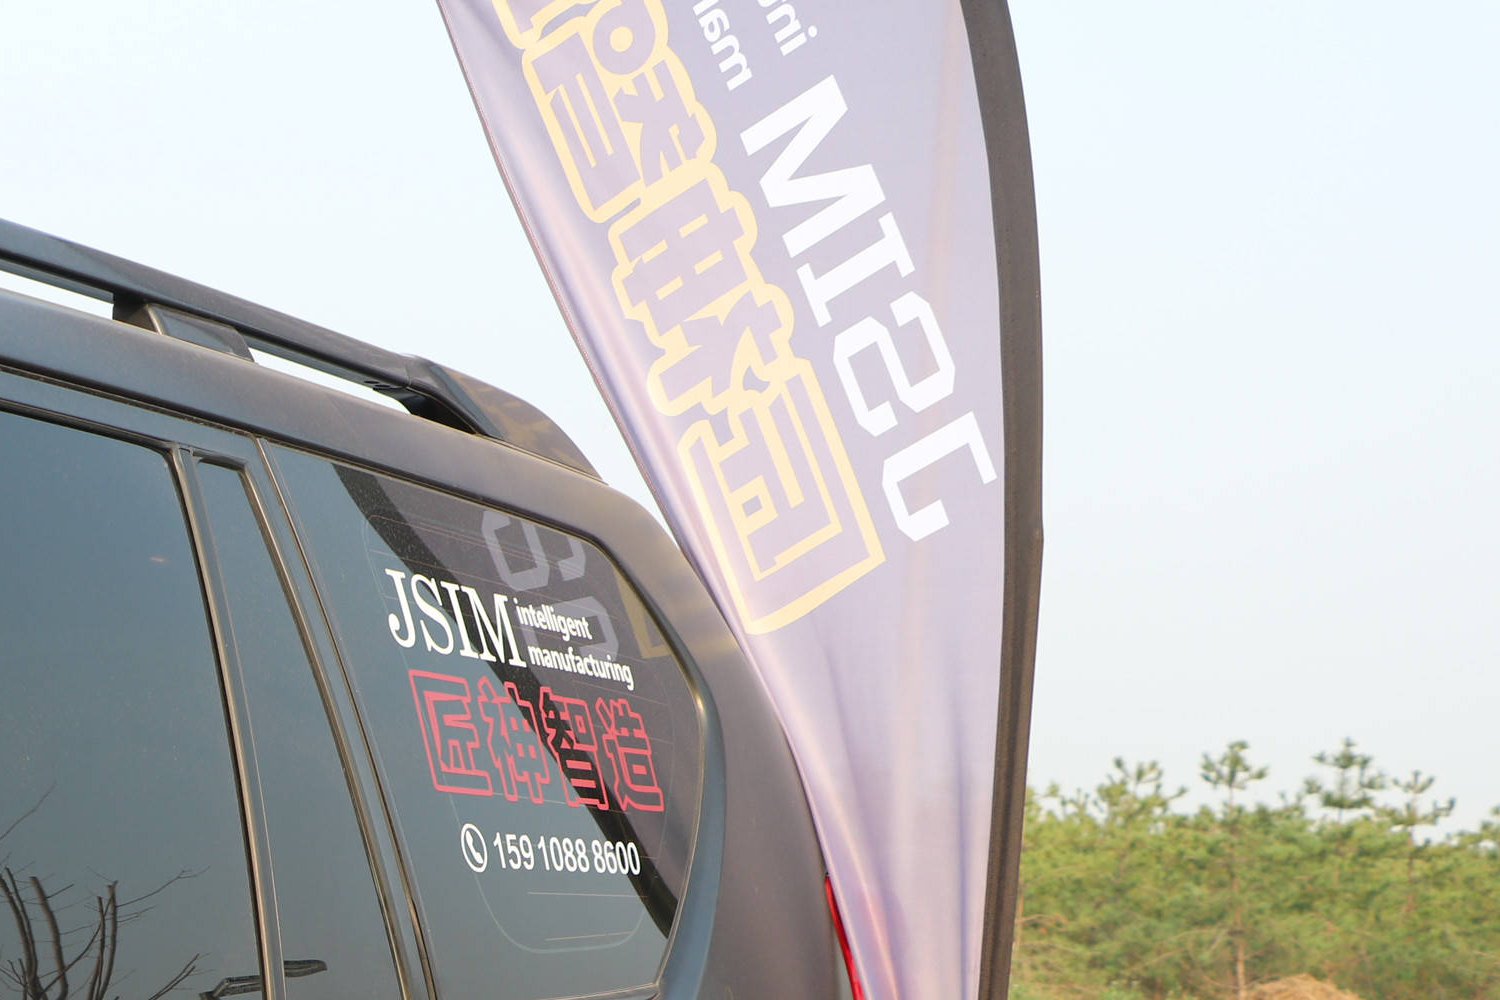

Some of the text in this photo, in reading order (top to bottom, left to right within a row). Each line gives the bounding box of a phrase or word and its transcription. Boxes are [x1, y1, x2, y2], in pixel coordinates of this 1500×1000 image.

[385, 567, 527, 669] JSIM
[513, 597, 593, 642] intelligent
[527, 646, 635, 692] manufacturing
[408, 668, 665, 813] 匠神智造
[493, 831, 641, 876] 159 1088 8600
